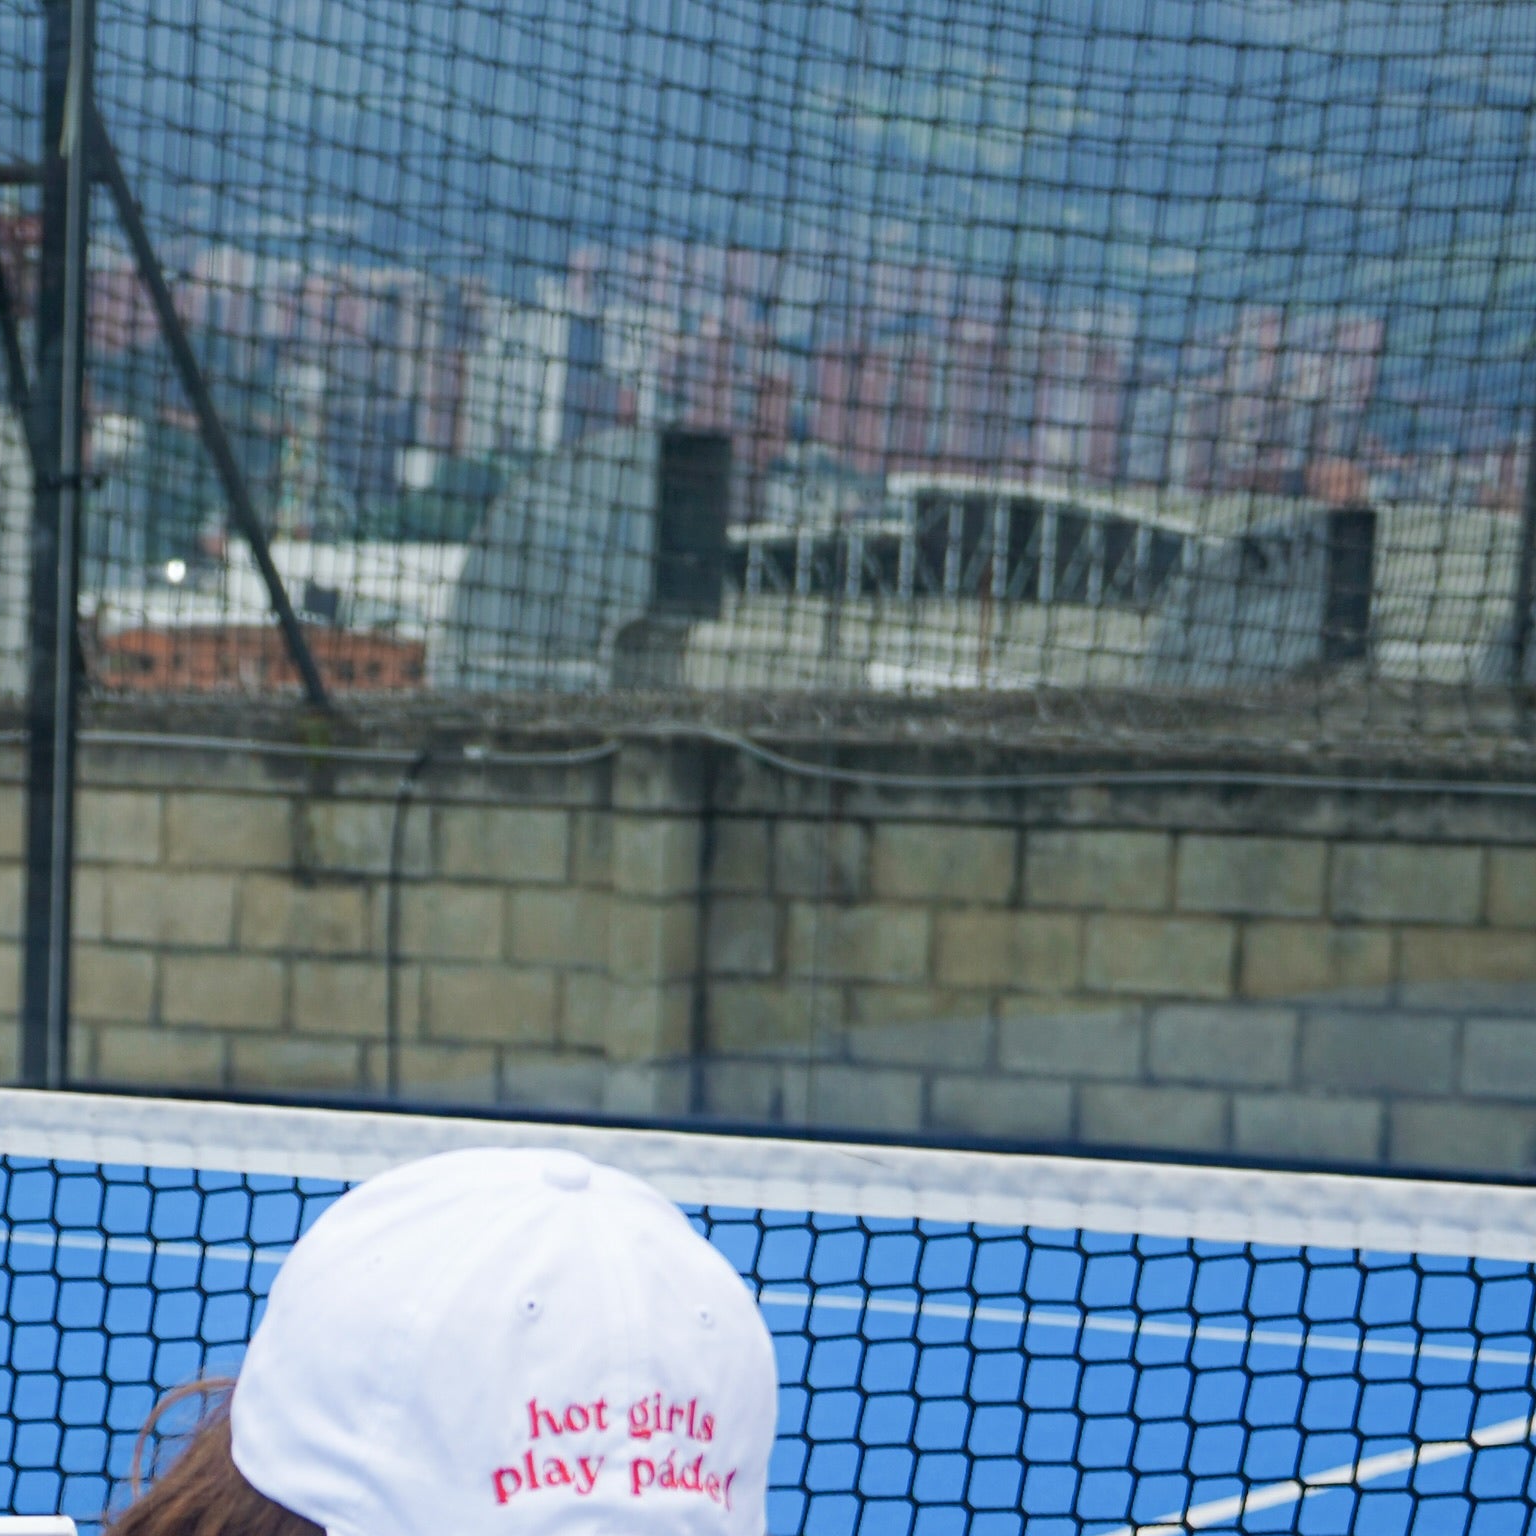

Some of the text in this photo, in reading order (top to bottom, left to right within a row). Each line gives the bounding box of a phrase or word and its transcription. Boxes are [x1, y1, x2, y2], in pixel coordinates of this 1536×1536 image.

[527, 1392, 716, 1442] hot girls
[491, 1447, 604, 1504] play
